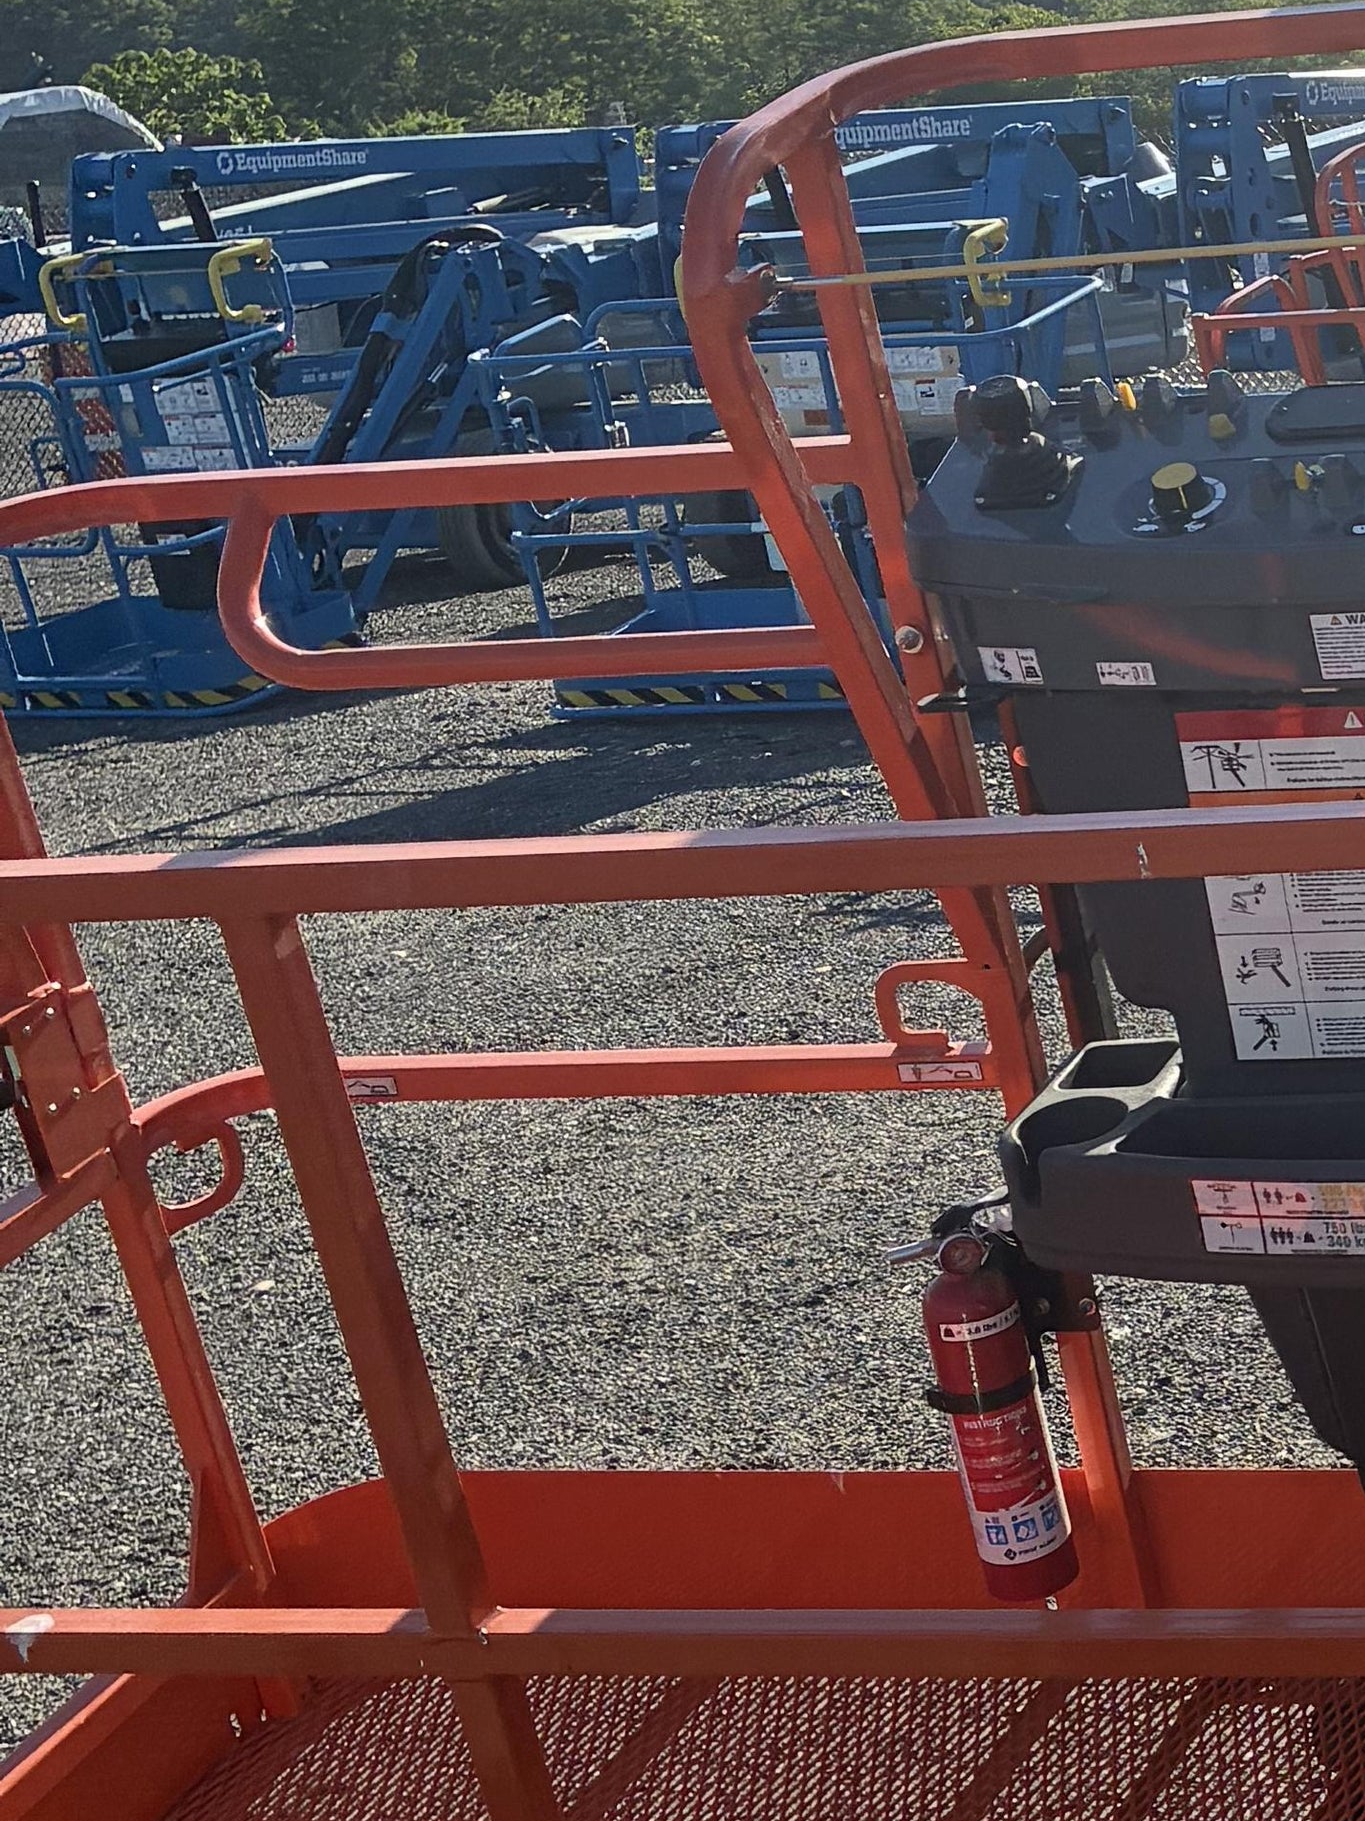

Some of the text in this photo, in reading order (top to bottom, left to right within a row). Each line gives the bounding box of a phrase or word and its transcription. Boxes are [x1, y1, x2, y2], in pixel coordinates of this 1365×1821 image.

[834, 115, 971, 150] quipmentShare
[236, 148, 367, 173] EquipmentShare
[1323, 1221, 1347, 1234] 750
[1327, 1235, 1352, 1248] 340
